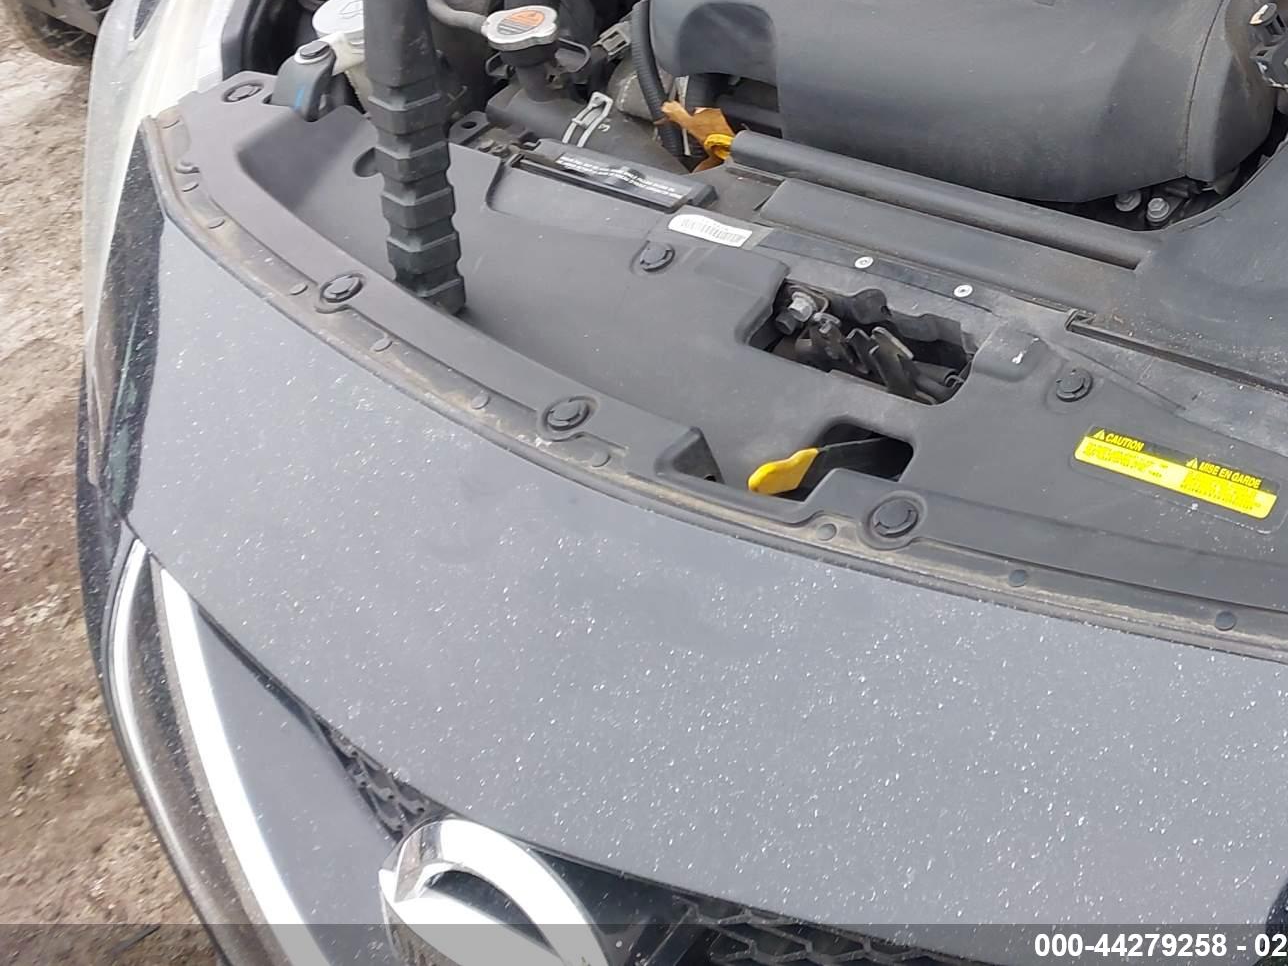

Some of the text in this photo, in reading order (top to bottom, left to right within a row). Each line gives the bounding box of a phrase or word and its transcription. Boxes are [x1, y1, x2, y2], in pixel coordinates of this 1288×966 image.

[1105, 433, 1145, 452] CAUTION
[1198, 461, 1262, 489] MISE EN GARDE
